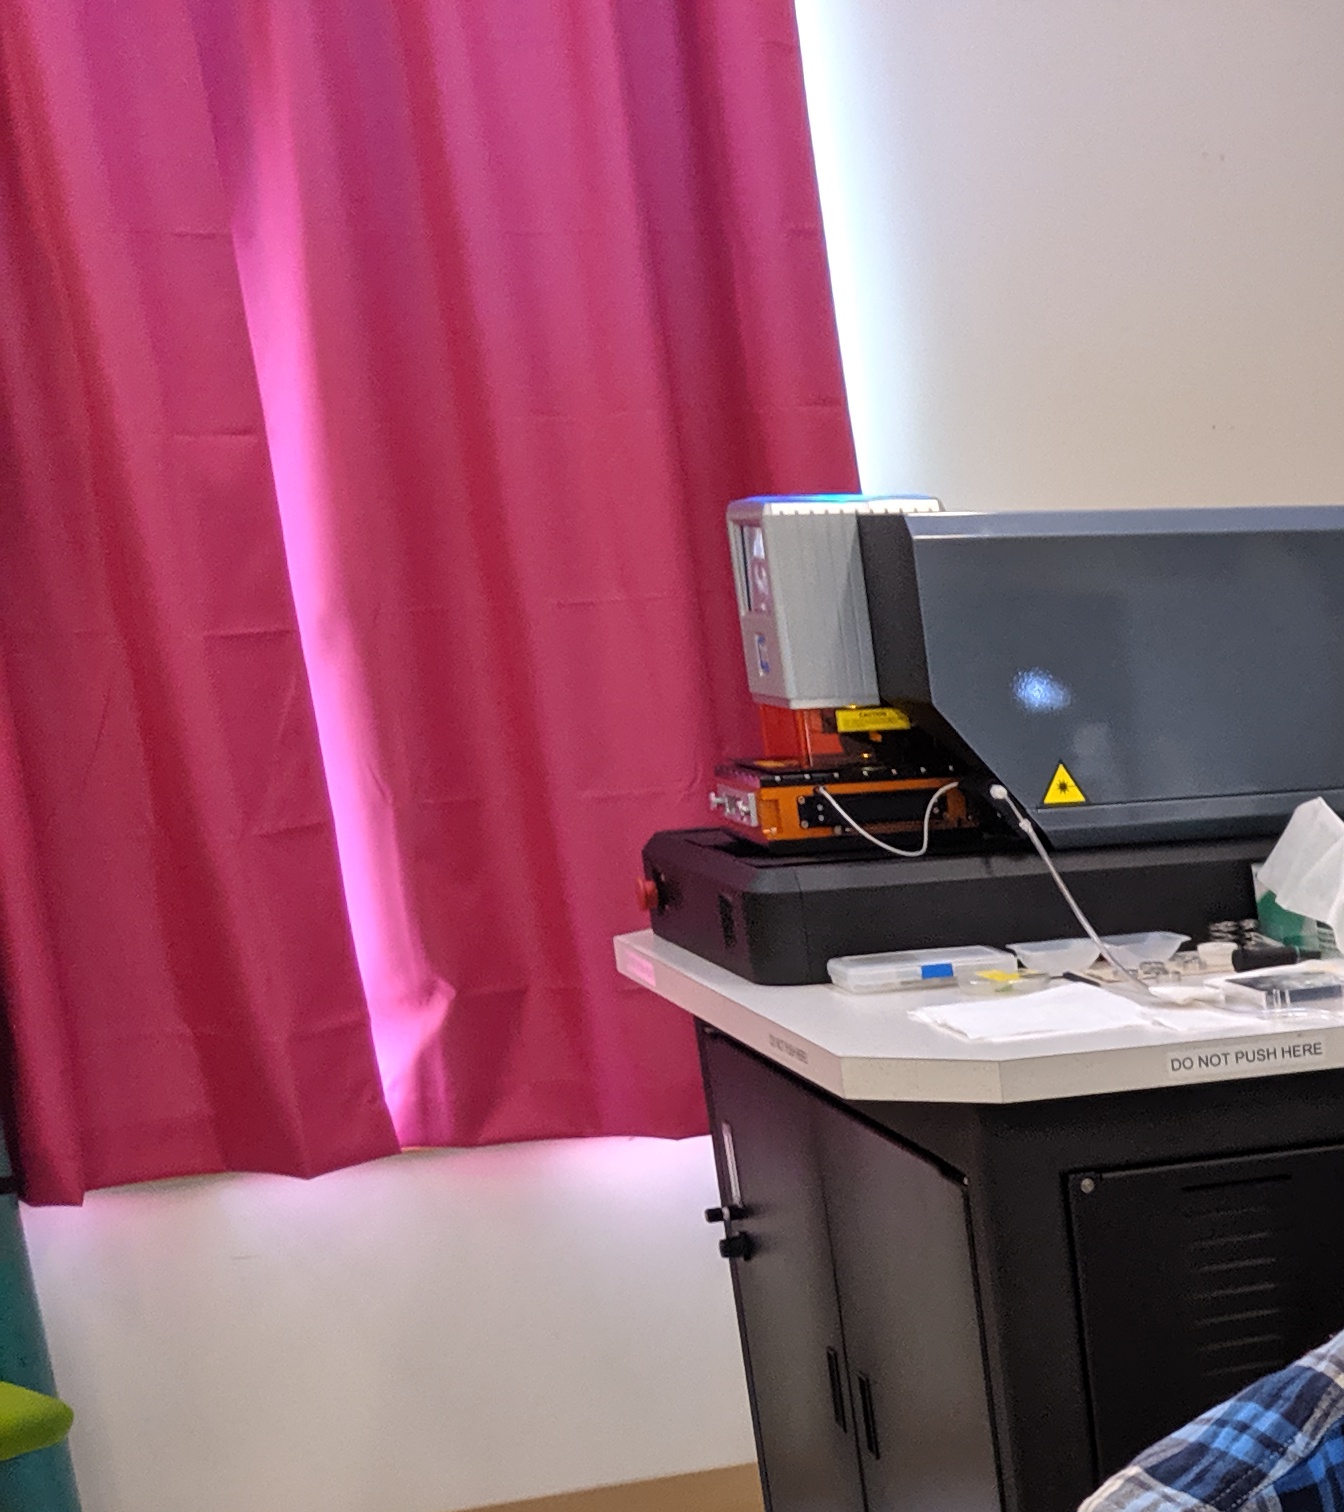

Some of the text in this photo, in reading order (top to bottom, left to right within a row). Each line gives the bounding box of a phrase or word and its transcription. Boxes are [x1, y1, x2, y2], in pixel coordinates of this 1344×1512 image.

[1170, 1042, 1323, 1072] DO NOT PUSH HERE
